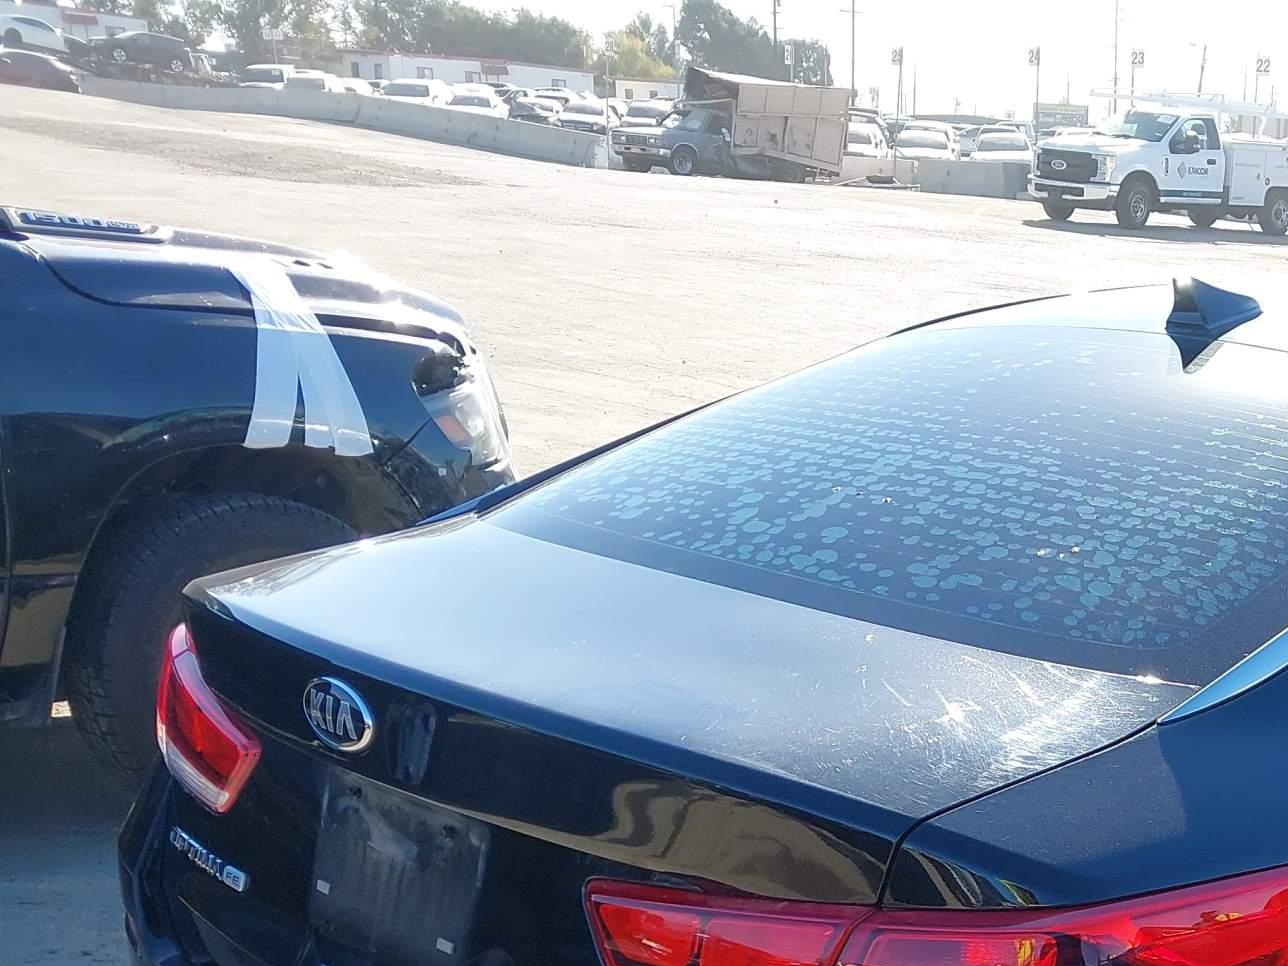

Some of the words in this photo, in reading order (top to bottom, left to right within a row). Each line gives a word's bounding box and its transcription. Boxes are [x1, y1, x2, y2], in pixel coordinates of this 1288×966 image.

[1131, 51, 1144, 65] 23
[1256, 59, 1270, 73] 22
[25, 211, 107, 228] 1500
[310, 688, 358, 740] KIA
[169, 826, 224, 881] OPTIMA
